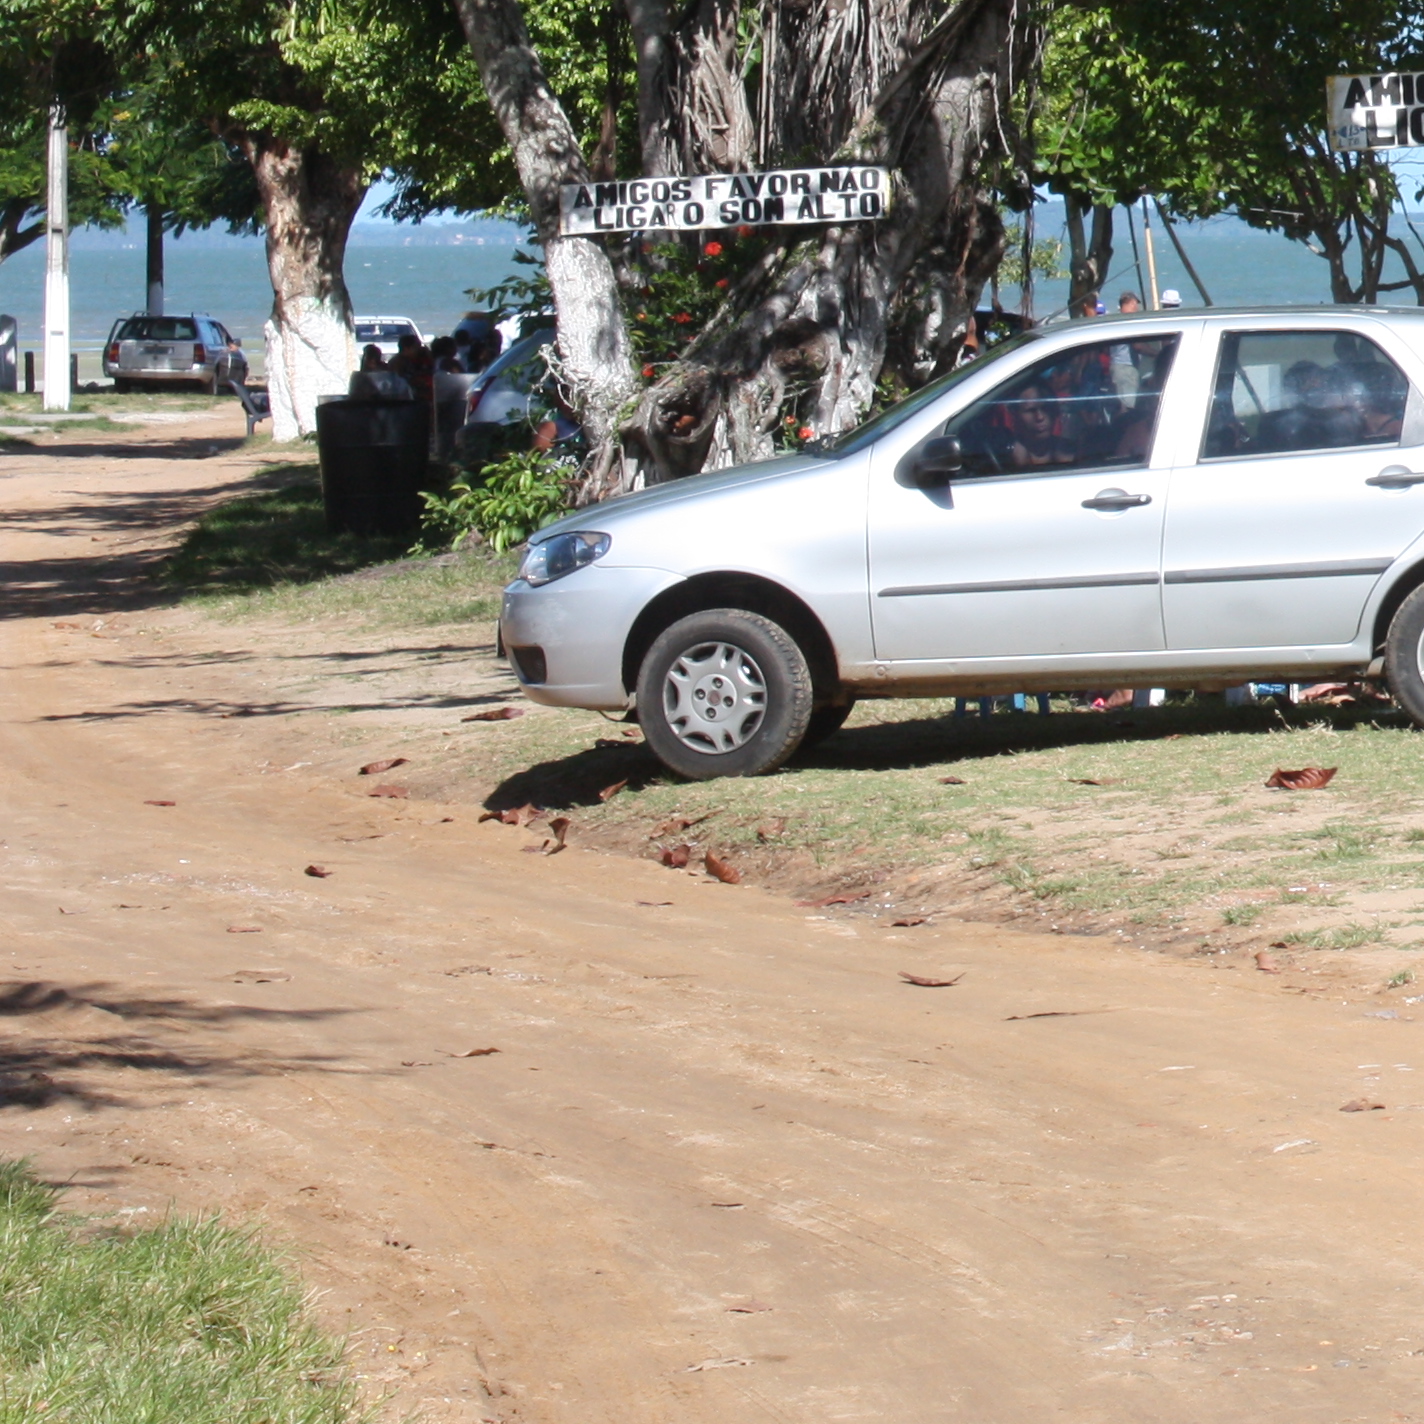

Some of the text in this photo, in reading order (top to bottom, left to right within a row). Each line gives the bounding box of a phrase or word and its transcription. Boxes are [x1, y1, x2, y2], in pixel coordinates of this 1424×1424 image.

[573, 168, 880, 209] AMIGOS FAVOR NAO
[720, 197, 784, 224] SOM
